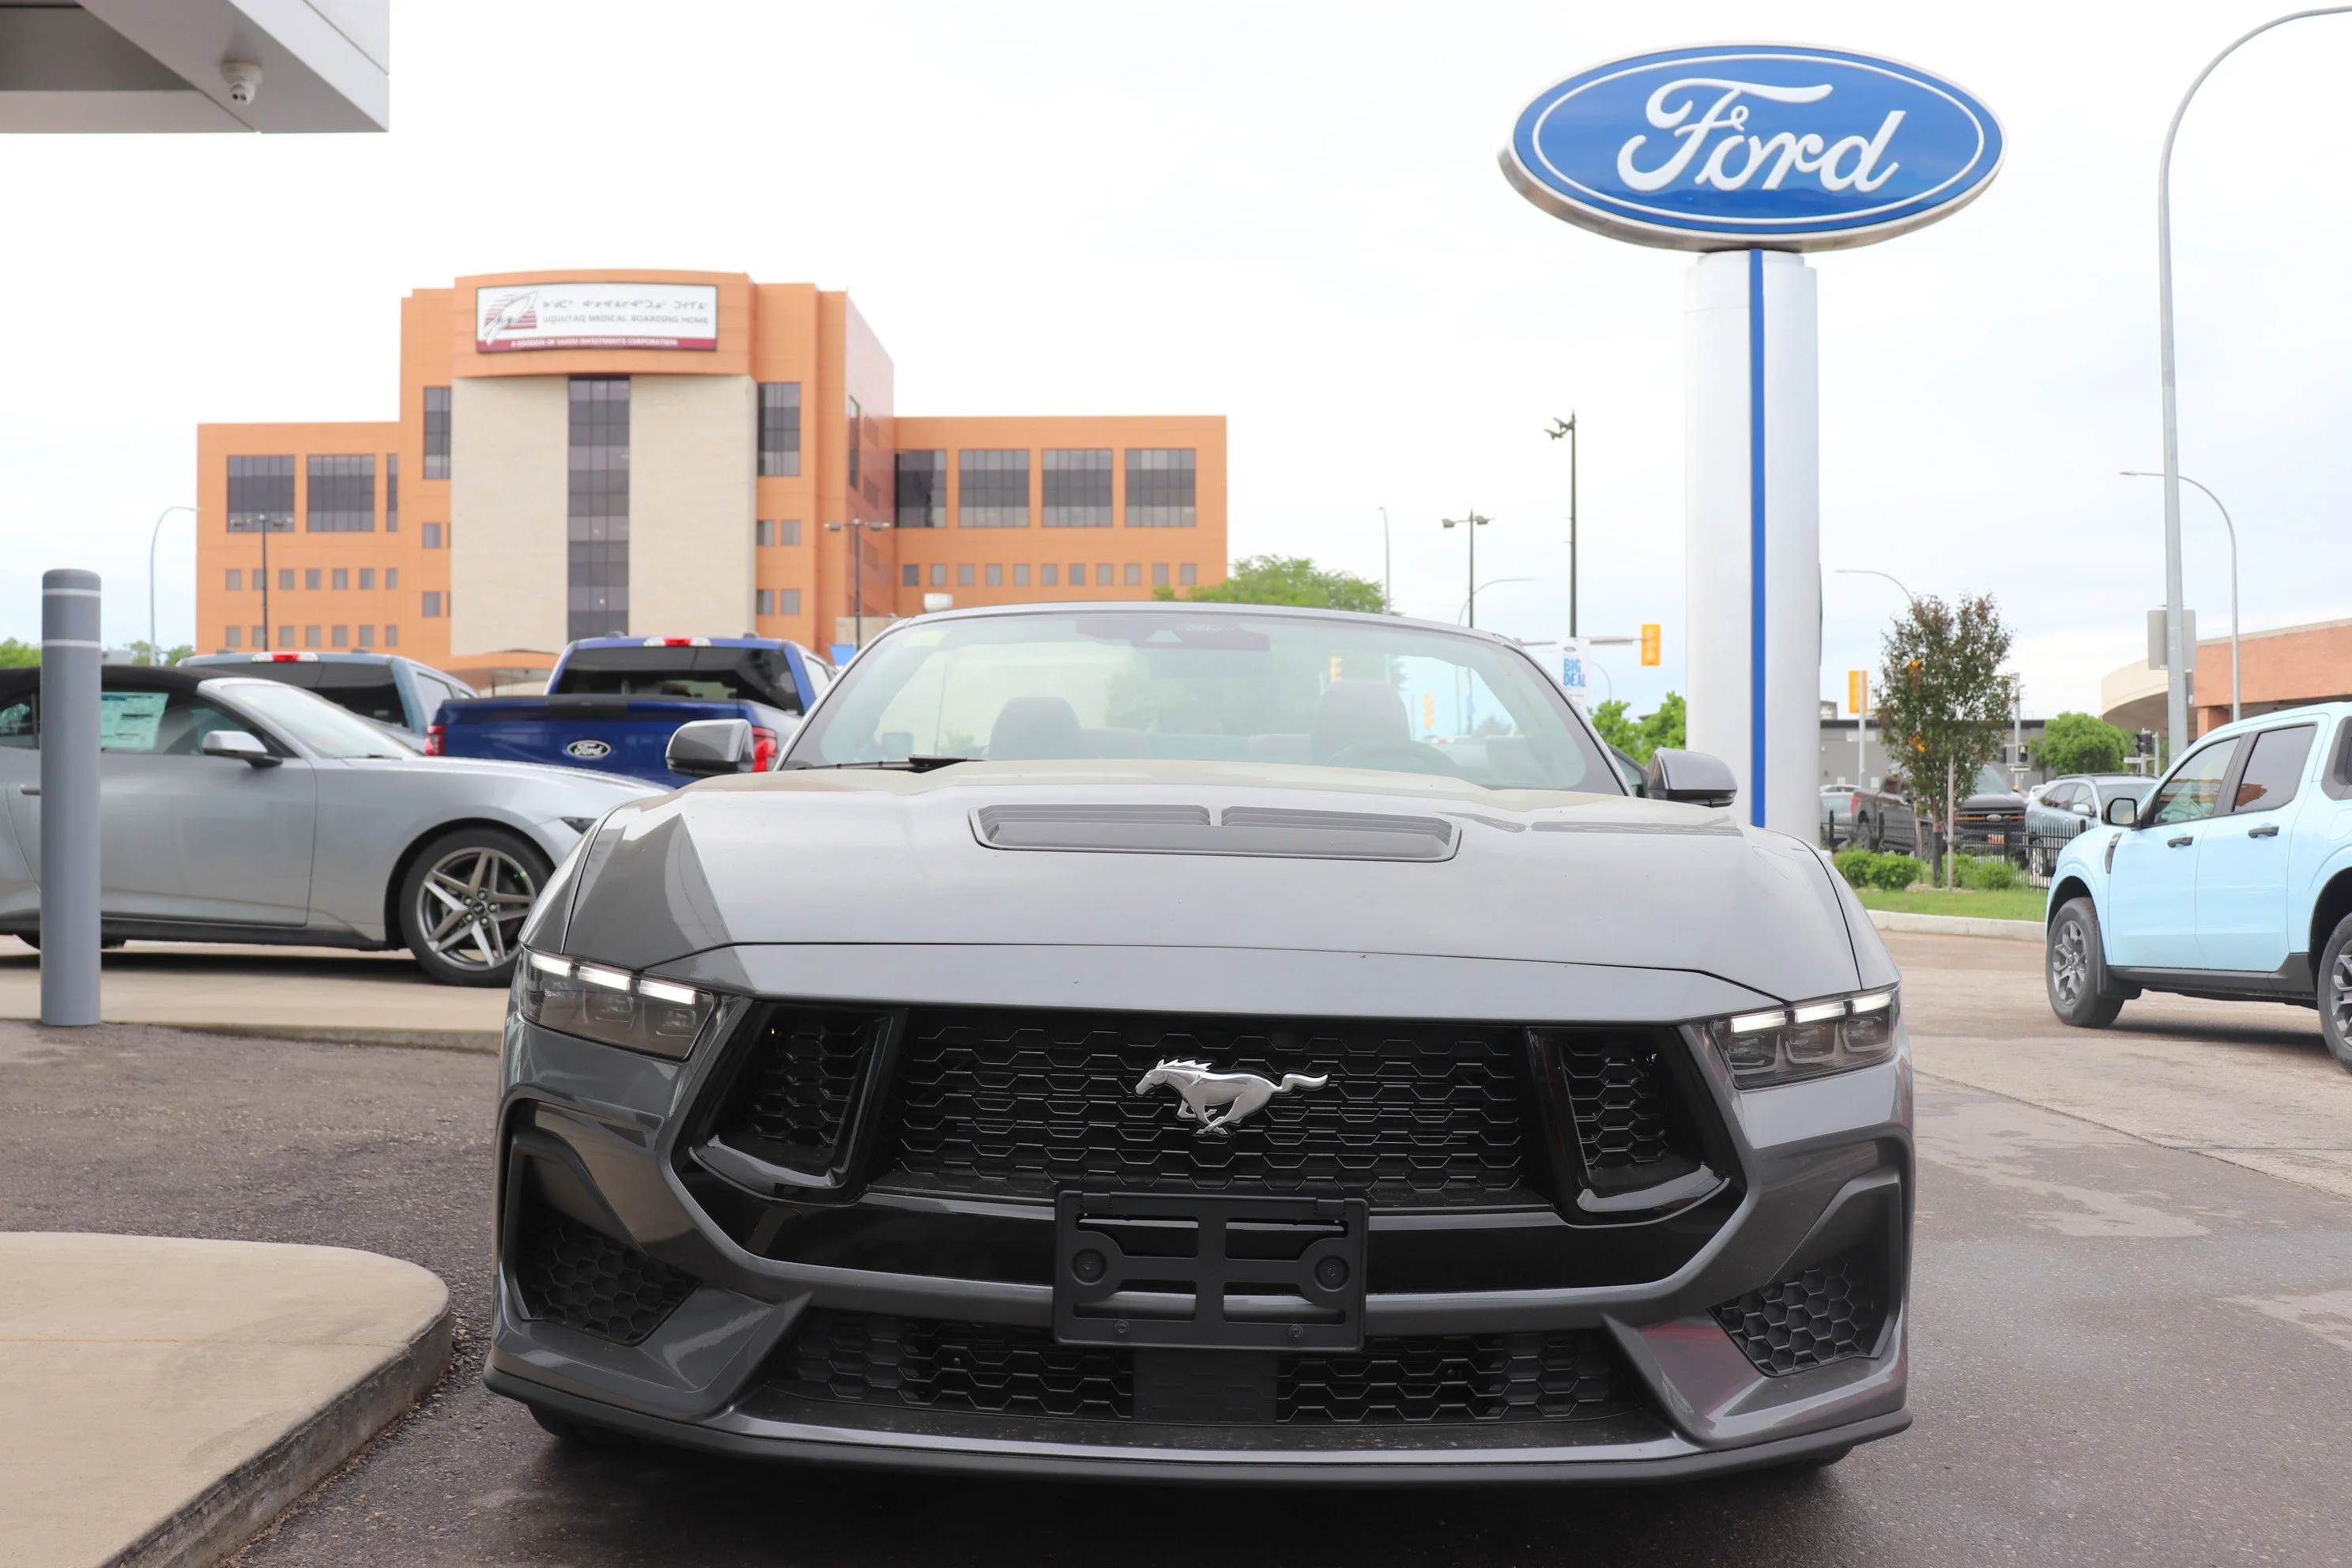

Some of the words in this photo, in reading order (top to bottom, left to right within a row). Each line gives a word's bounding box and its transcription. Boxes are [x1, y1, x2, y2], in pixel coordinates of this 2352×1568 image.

[1616, 77, 1906, 193] Ford
[588, 314, 626, 322] MEDICAL
[631, 315, 678, 323] BOARDING
[1563, 658, 1581, 673] BIG
[1563, 673, 1585, 687] DEAL
[574, 743, 604, 756] Ford
